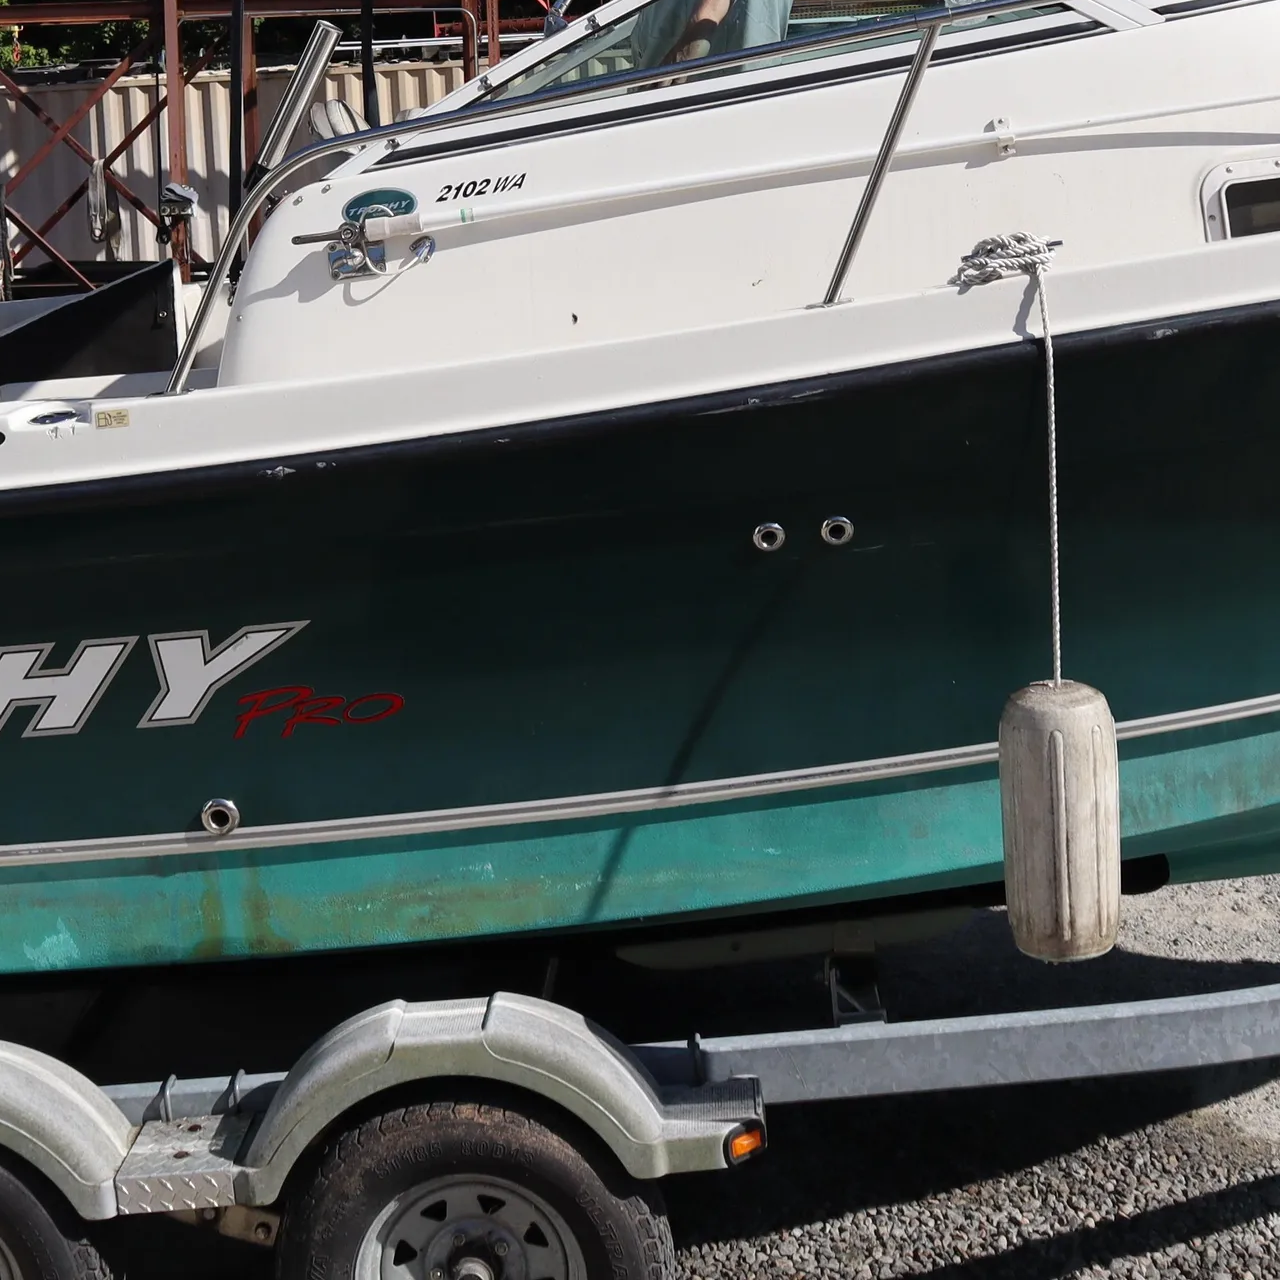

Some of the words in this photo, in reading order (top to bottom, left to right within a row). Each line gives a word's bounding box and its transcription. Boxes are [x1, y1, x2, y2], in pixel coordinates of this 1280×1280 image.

[435, 178, 492, 202] 2102
[492, 172, 527, 194] WA
[233, 685, 405, 739] PRO
